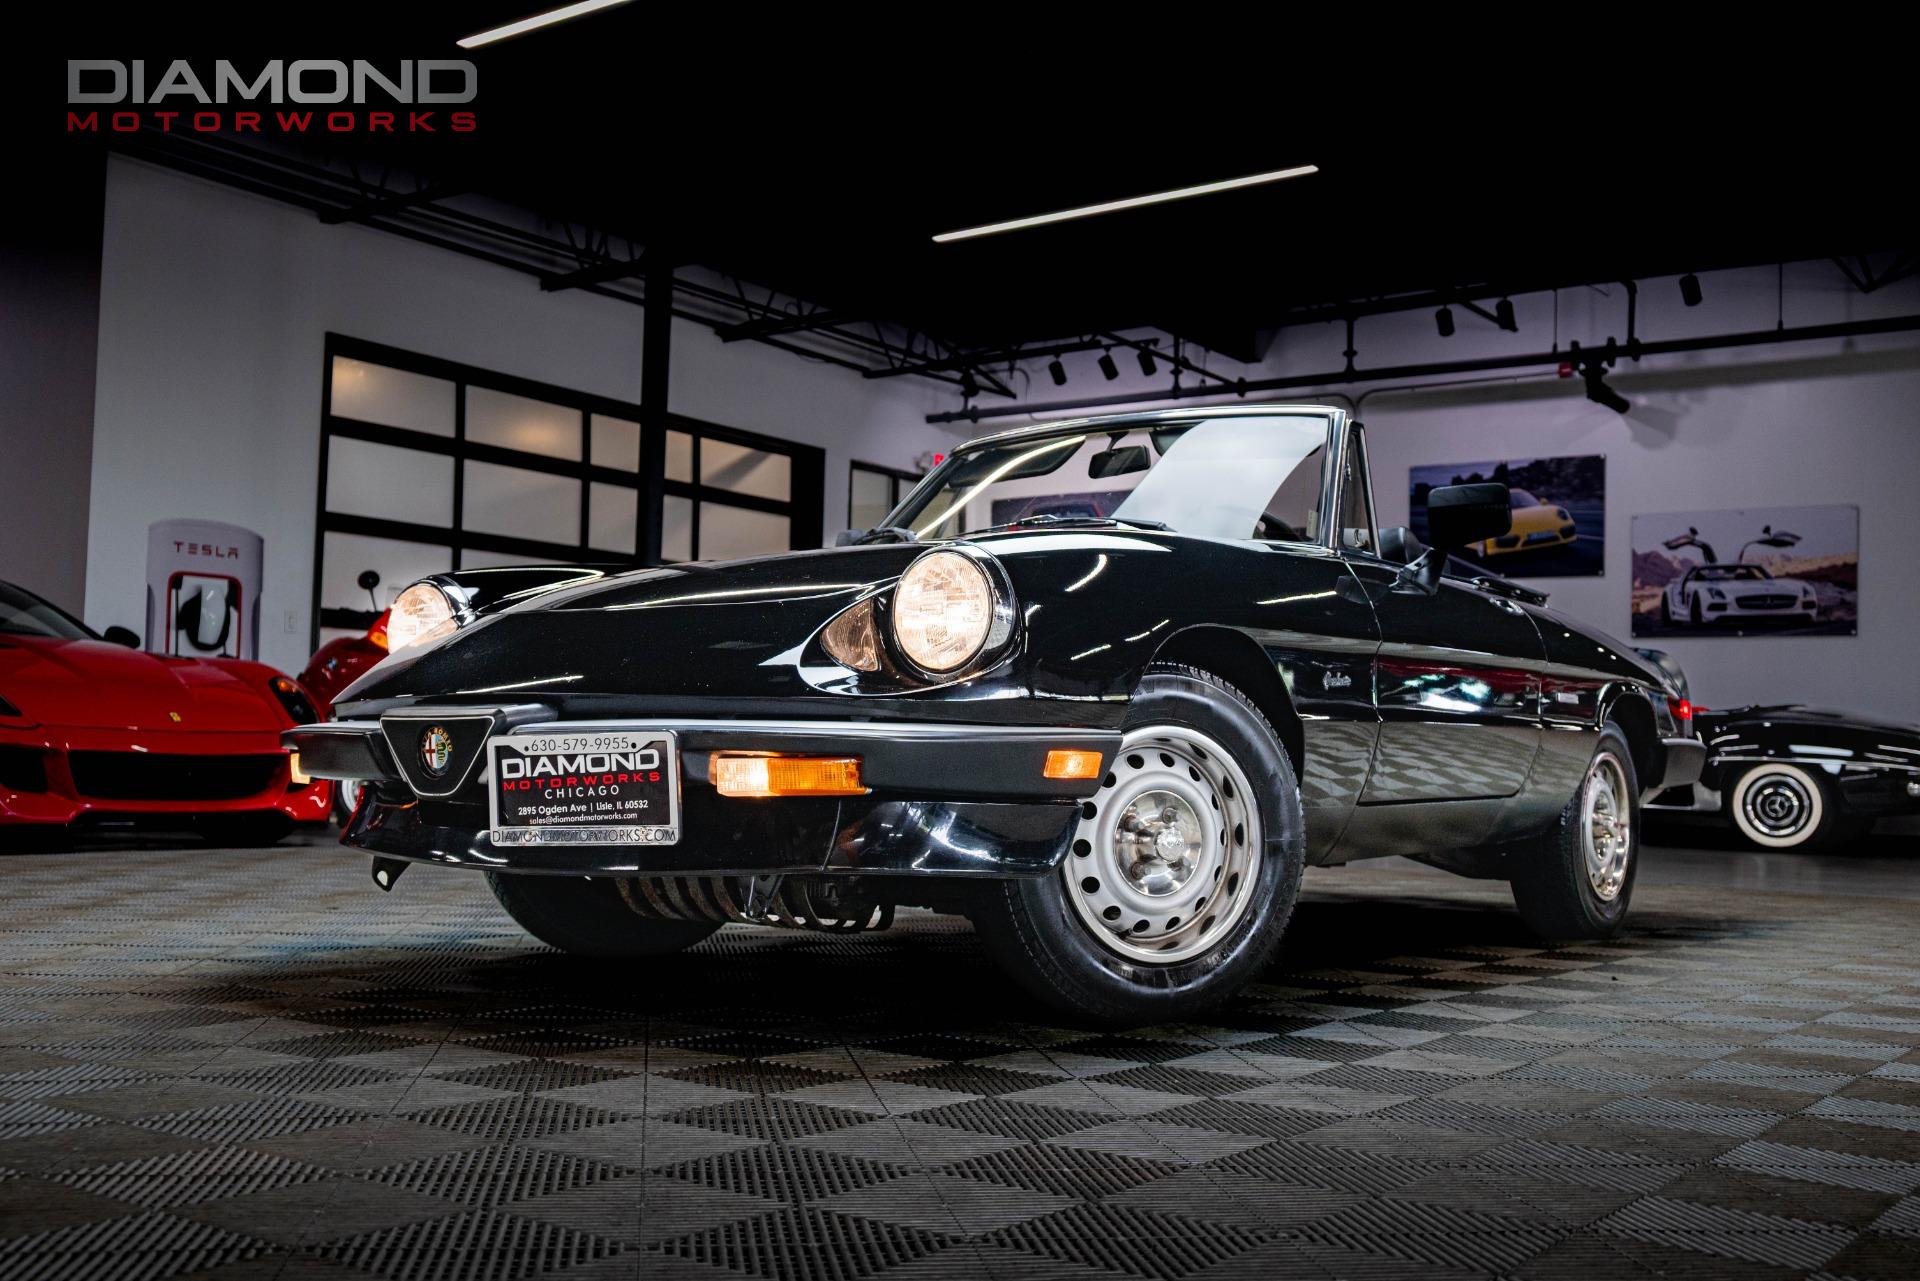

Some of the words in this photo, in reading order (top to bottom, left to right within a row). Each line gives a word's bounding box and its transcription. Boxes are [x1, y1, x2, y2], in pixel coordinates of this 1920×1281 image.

[174, 541, 238, 559] TESLA
[531, 737, 629, 752] 630-579-9955
[501, 749, 660, 779] DIAMOND
[503, 771, 660, 791] MOTORWORKS
[545, 785, 619, 800] CHICAGO
[518, 806, 536, 816] 2895
[538, 804, 568, 815] Ogden
[570, 804, 587, 813] Ave
[617, 802, 623, 810] IL
[625, 800, 648, 810] 60532
[529, 811, 638, 825] sales@diamondmotorworks.com
